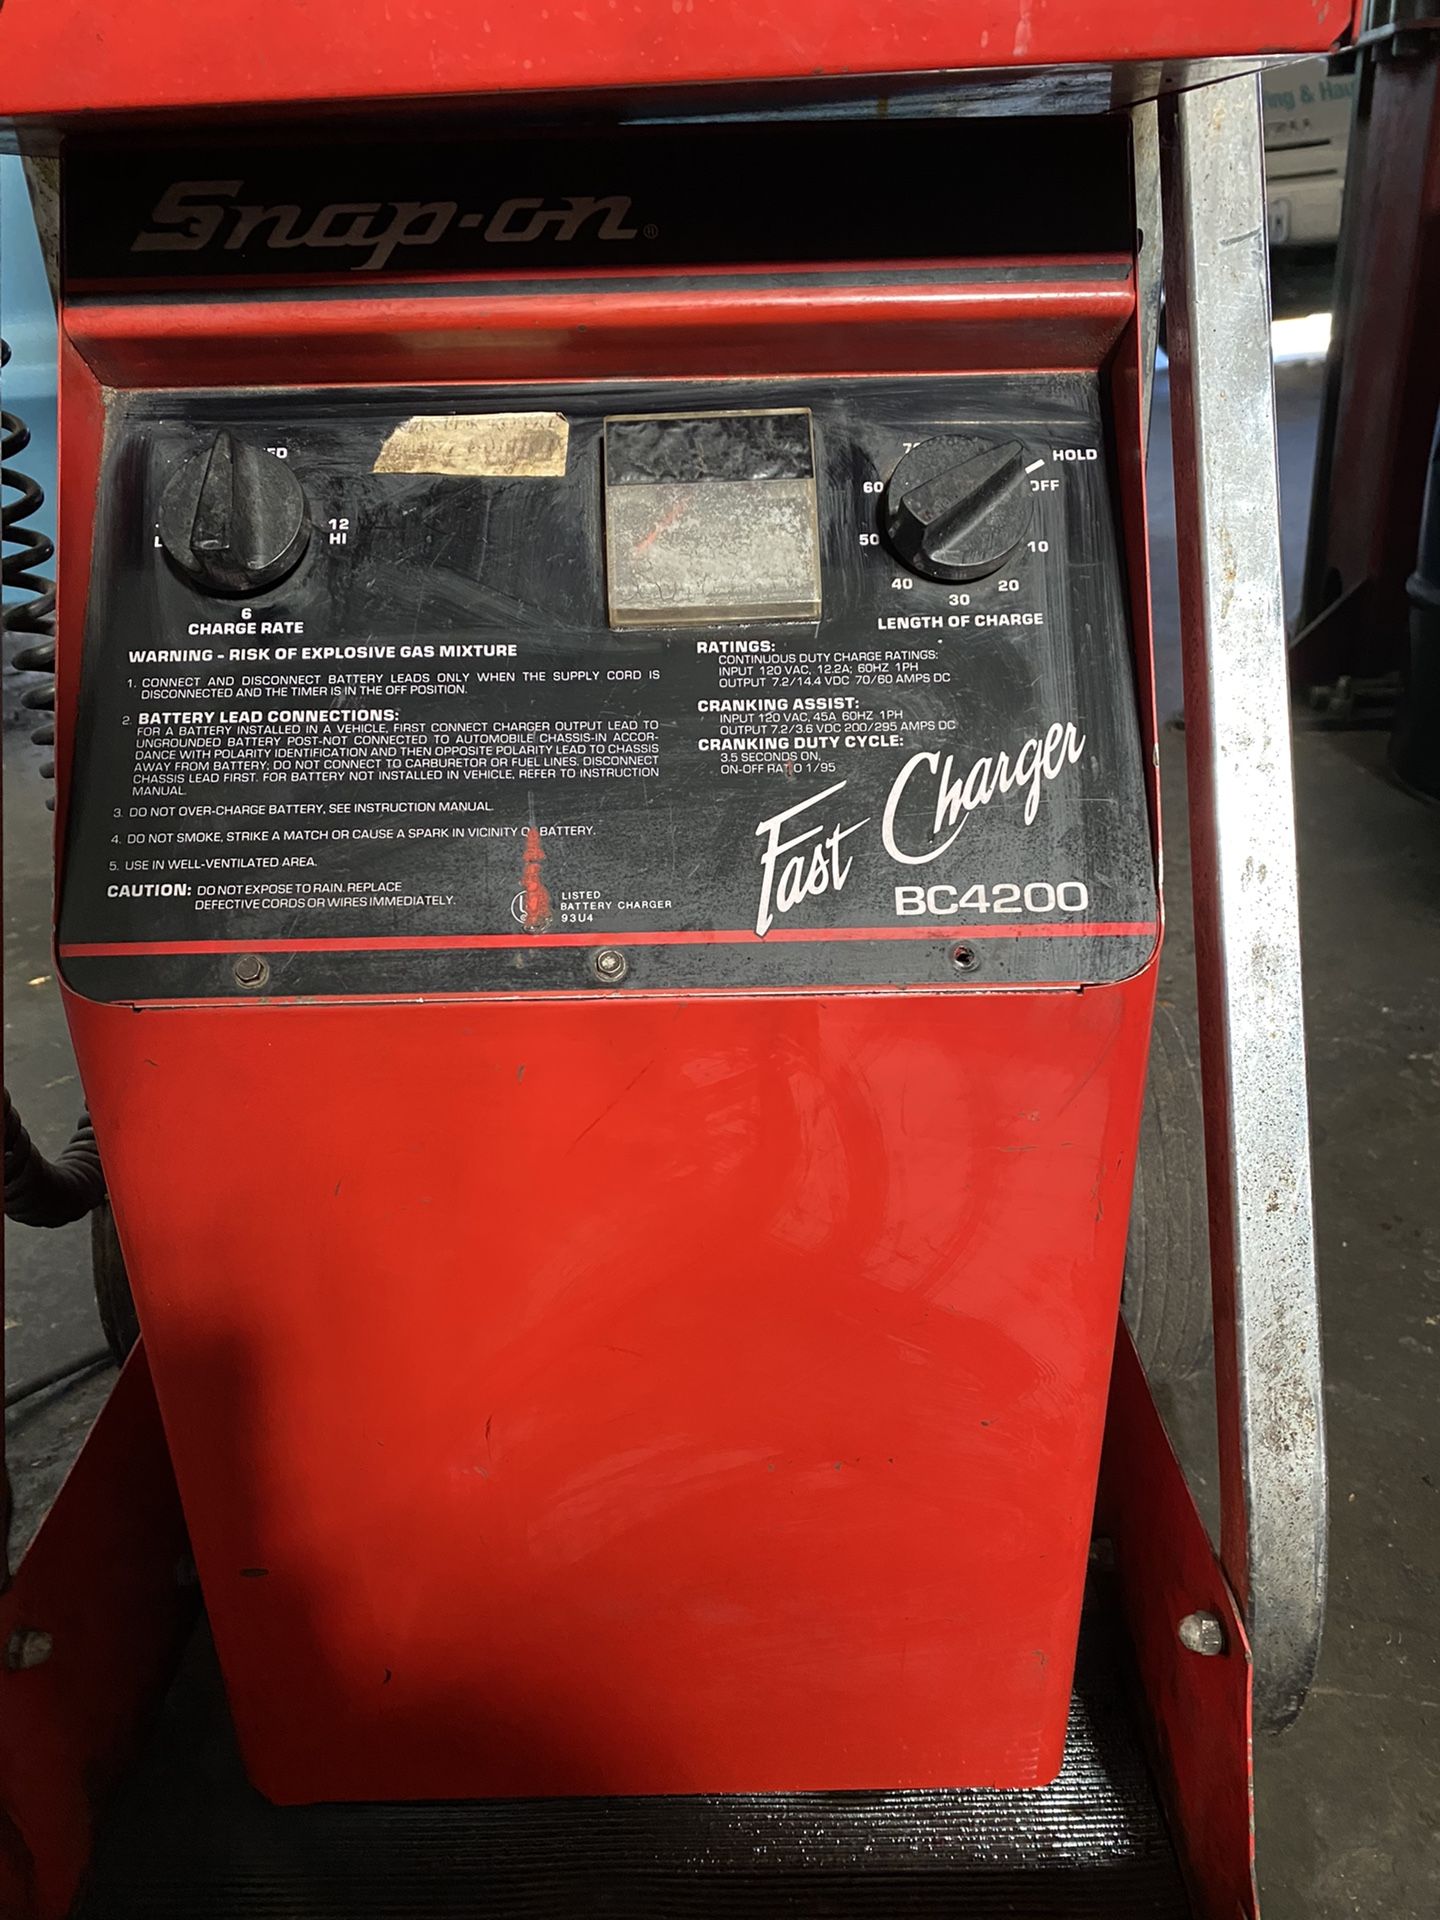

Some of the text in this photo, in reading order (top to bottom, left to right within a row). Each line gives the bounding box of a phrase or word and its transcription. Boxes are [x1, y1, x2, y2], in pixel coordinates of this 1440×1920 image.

[130, 180, 638, 270] Snap-on
[1052, 449, 1098, 461] HOLD
[863, 482, 884, 493] 60
[328, 519, 349, 529] 12
[329, 533, 347, 544] HI
[859, 534, 879, 545] 50
[1028, 541, 1049, 552] 10
[891, 579, 913, 590] 40
[998, 580, 1019, 591] 20
[949, 595, 970, 606] 30
[241, 608, 252, 619] 6
[877, 612, 1044, 629] LENGTH OF CHARGE
[187, 621, 304, 635] CHARGE RATE
[128, 649, 213, 662] WARNING
[228, 647, 270, 660] RISK
[274, 647, 297, 660] OF
[301, 645, 395, 659] EXPLOSIVE
[399, 645, 435, 658] GAS
[439, 643, 517, 657] MIXTURE
[696, 640, 775, 653] RATINGS:
[718, 649, 938, 664] CONTINUOUS DUTY CHARGE RATINGS:
[718, 661, 919, 676] INPUT 120 VAC, 12.2A; 60HZ 1PH
[141, 676, 201, 687] CONNECT
[207, 675, 234, 686] AND
[241, 674, 321, 685] DISCONNECT
[328, 673, 383, 684] BATTERY
[390, 672, 430, 683] LEADS
[436, 672, 470, 682] ONLY
[476, 671, 515, 682] WHEN
[522, 671, 546, 681] THE
[552, 670, 600, 681] SUPPLY
[606, 669, 642, 680] CORD
[648, 669, 660, 679] IS
[718, 671, 951, 688] OUTPUT 7.2/14.4 VDC 70/60 AMPS DC
[141, 683, 467, 699] DISCONNECTED AND THE TIMER IS IN THE OFF POSITION.
[697, 696, 859, 712] CRANKING ASSIST:
[138, 711, 215, 724] BATTERY
[219, 710, 263, 723] LEAD
[267, 708, 399, 723] CONNECTIONS:
[719, 709, 903, 724] INPUT 120 VAC, 45A 60HZ 1PH
[137, 719, 659, 736] FOR A BATTERY INSTALLED IN A VEHICLE, FIRST CONNECT CHARGER OUTPUT LEAD TO
[719, 719, 956, 735] OUTPUT 7.2/3.6 VDC 200/295 AMPS DC
[698, 734, 904, 751] CRANKING DUTY CYCLE:
[720, 750, 821, 762] 3.5 SECONDS ON.
[720, 761, 836, 774] ON-OFF RAO 1/95
[129, 807, 147, 817] DO
[150, 806, 176, 817] NOT
[178, 804, 266, 816] OVER-CHARGE
[268, 803, 326, 814] BATTERY,
[328, 802, 351, 813] SEE
[353, 801, 435, 813] INSTRUCTION
[438, 800, 494, 812] MANUAL.
[127, 833, 145, 843] DO
[148, 832, 174, 843] NOT
[176, 831, 223, 843] SMOKE,
[226, 830, 269, 841] STRIKE
[271, 830, 280, 840] A
[283, 829, 328, 840] MATCH
[331, 829, 350, 840] OR
[352, 828, 393, 839] CAUSE
[396, 828, 405, 838] A
[408, 827, 449, 838] SPARK
[452, 827, 465, 837] IN
[467, 826, 518, 837] VICINITY
[539, 824, 596, 836] BATTERY.
[755, 721, 1086, 937] Fast Charger
[125, 859, 149, 870] USE
[152, 859, 165, 869] IN
[167, 856, 279, 869] WELL-VENTILATED
[281, 856, 317, 867] AREA.
[107, 881, 402, 898] CAUTION: DO NOT EXPOSE TO RAIN. REPLACE
[561, 890, 601, 900] LISTED
[194, 894, 456, 910] DEFECTIVE CORDS OR WIRES IMMEDIATELY.
[560, 899, 672, 910] BATTERY CHARGER
[894, 882, 1089, 916] BC4200
[561, 913, 593, 922] 93U4
